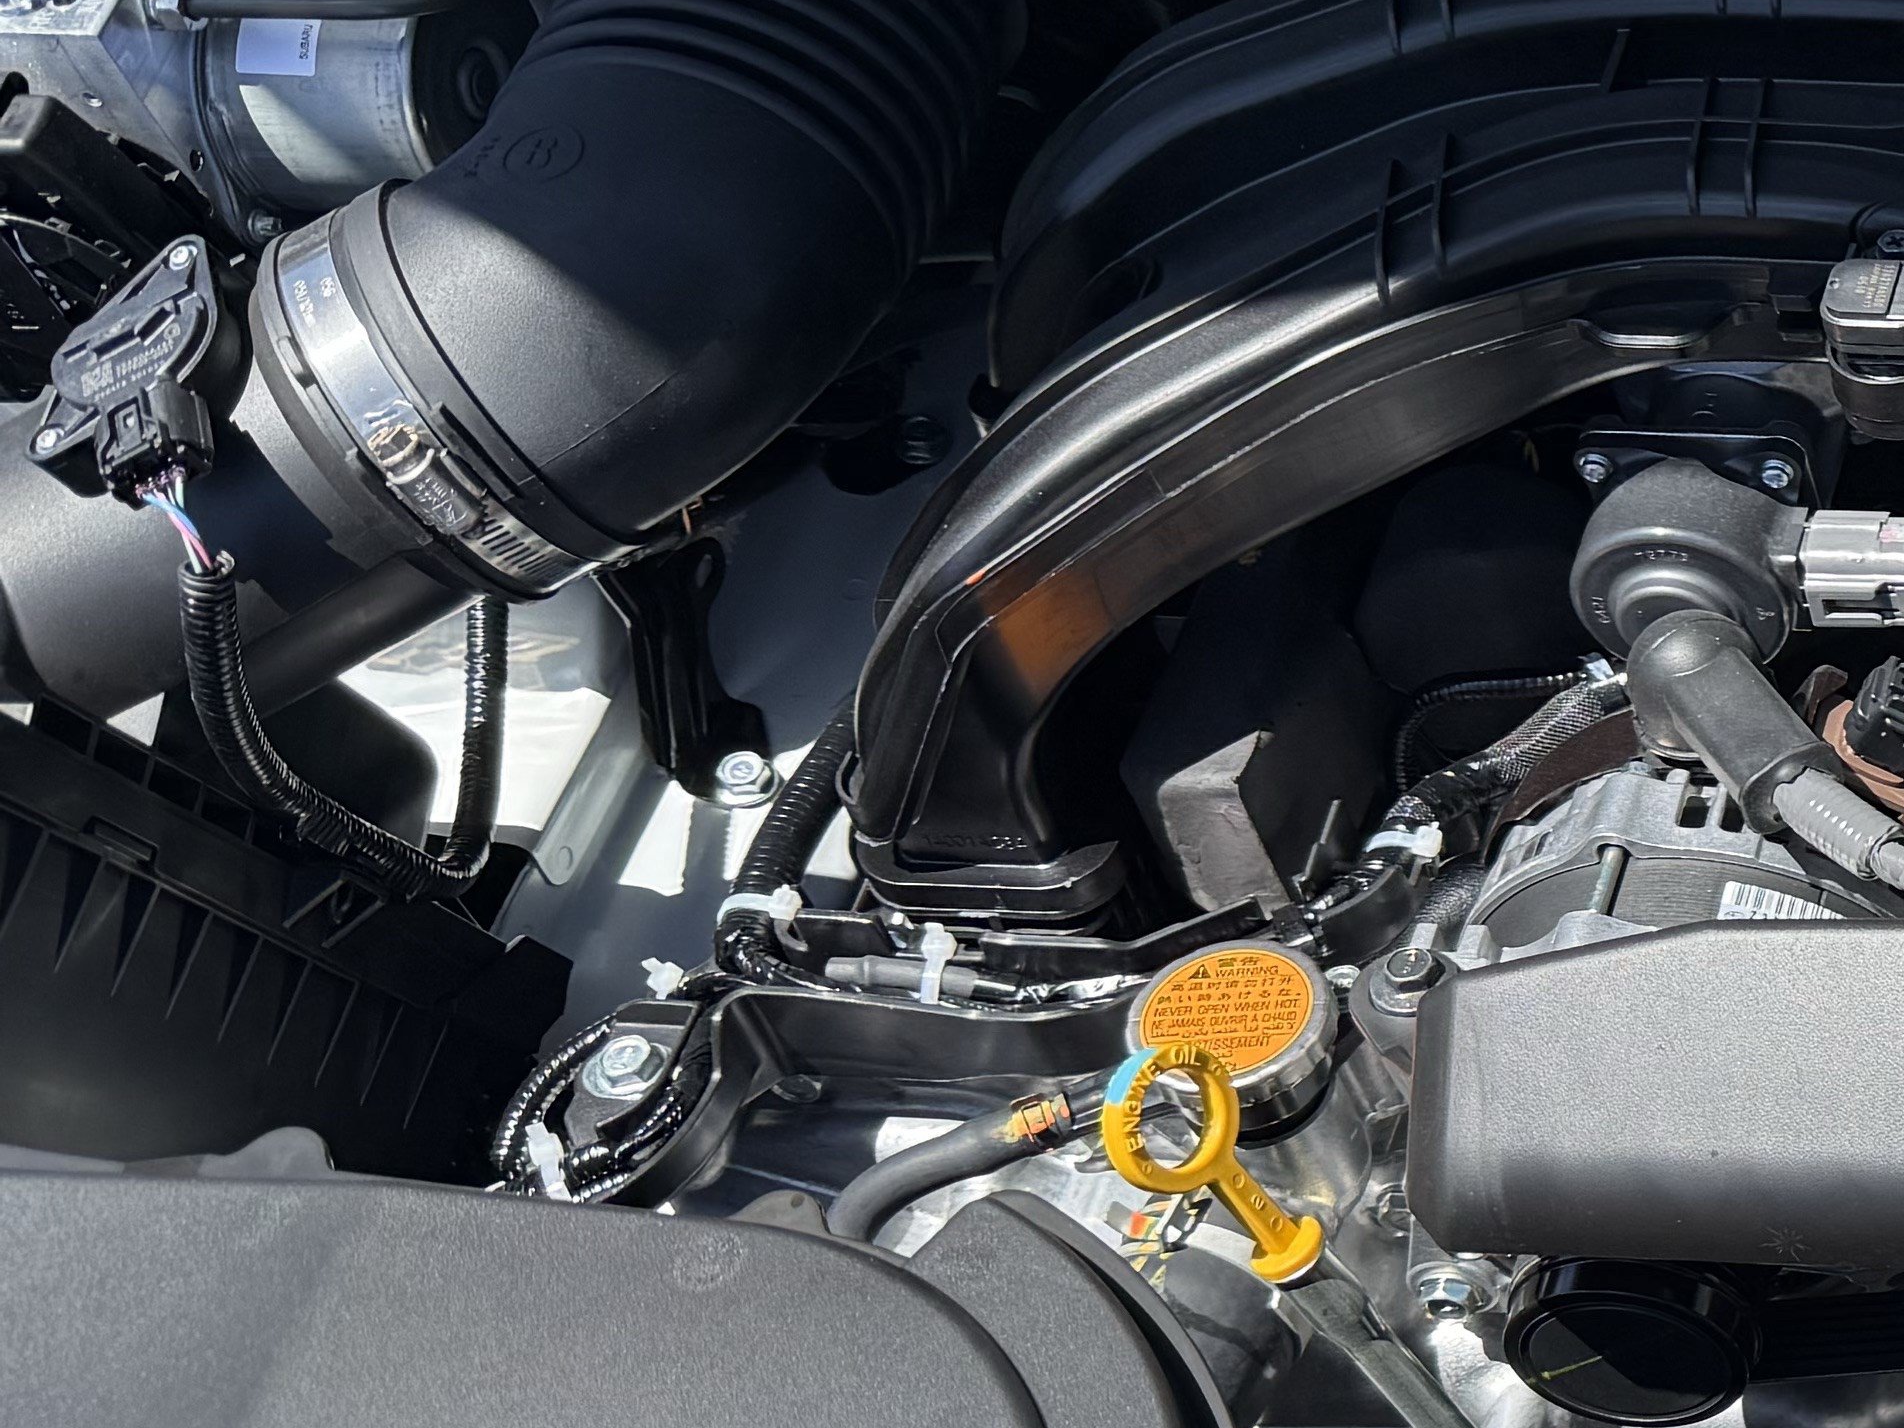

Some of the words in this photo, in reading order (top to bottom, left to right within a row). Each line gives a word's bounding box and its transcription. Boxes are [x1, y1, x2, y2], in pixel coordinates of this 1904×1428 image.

[298, 24, 313, 59] SUBARU
[1216, 966, 1279, 978] WARNING
[1154, 1006, 1192, 1017] NEVER
[1198, 1003, 1229, 1014] OPEN
[1234, 1001, 1269, 1011] WHEN
[1123, 1060, 1160, 1153] ENGINE
[1170, 1045, 1201, 1065] OIL
